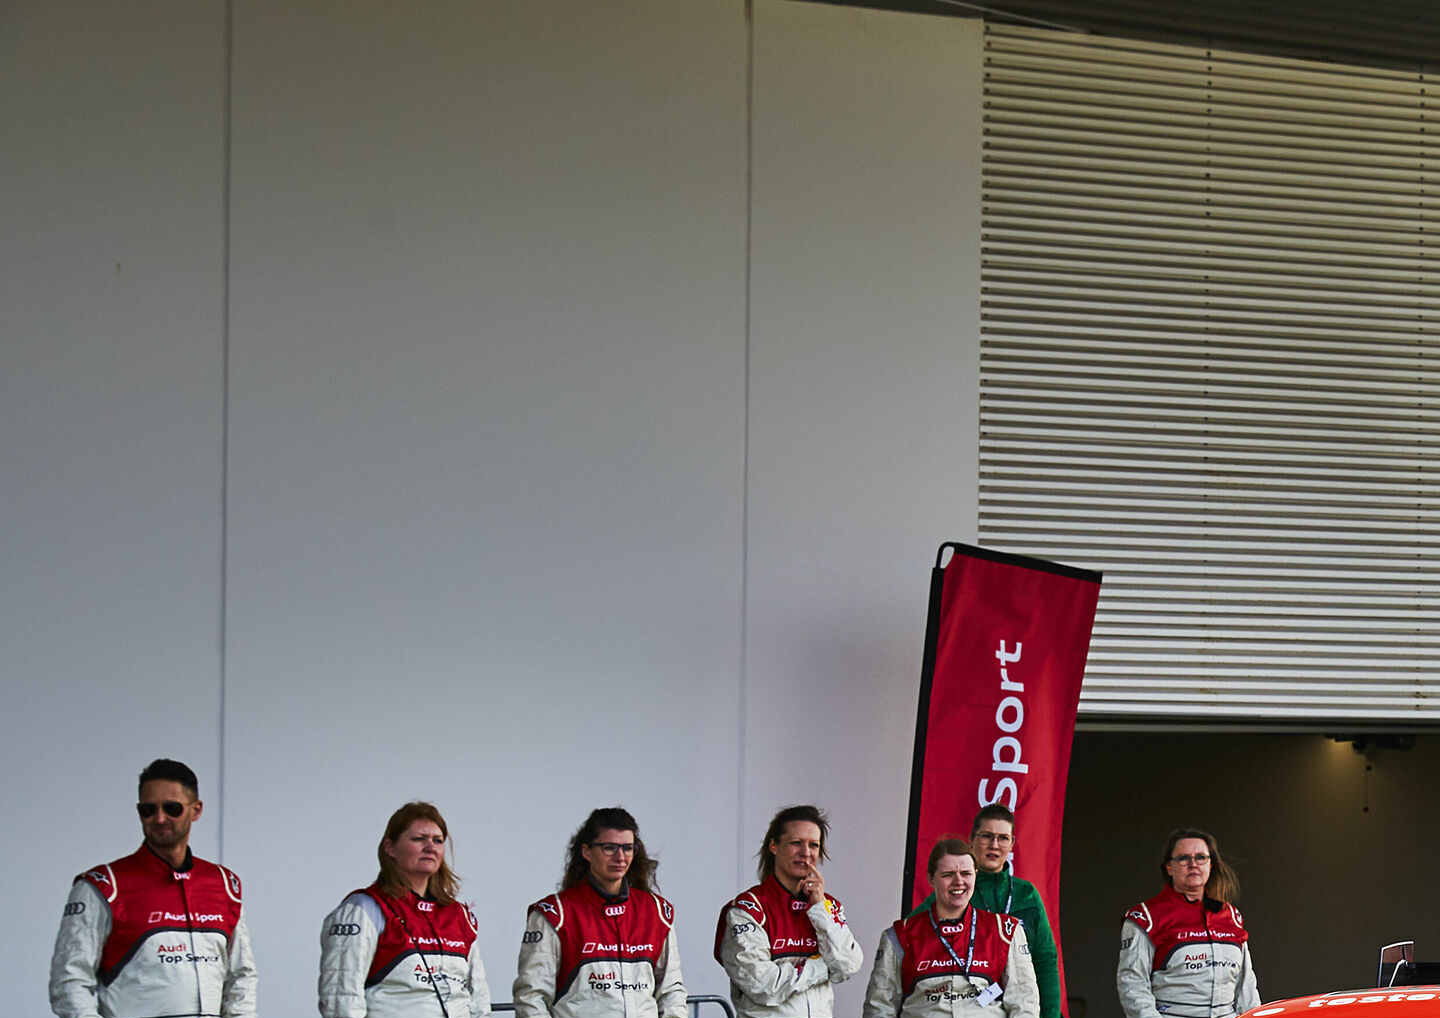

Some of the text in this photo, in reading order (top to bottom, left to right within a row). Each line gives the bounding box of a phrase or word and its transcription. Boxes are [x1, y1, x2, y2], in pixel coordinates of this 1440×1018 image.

[978, 639, 1029, 813] Sport
[158, 943, 187, 954] Audi
[596, 942, 625, 952] Audi
[158, 953, 183, 964] Top
[1184, 952, 1207, 962] Audi
[1184, 961, 1203, 970] Top
[588, 971, 616, 981] Audi
[588, 981, 612, 992] Top
